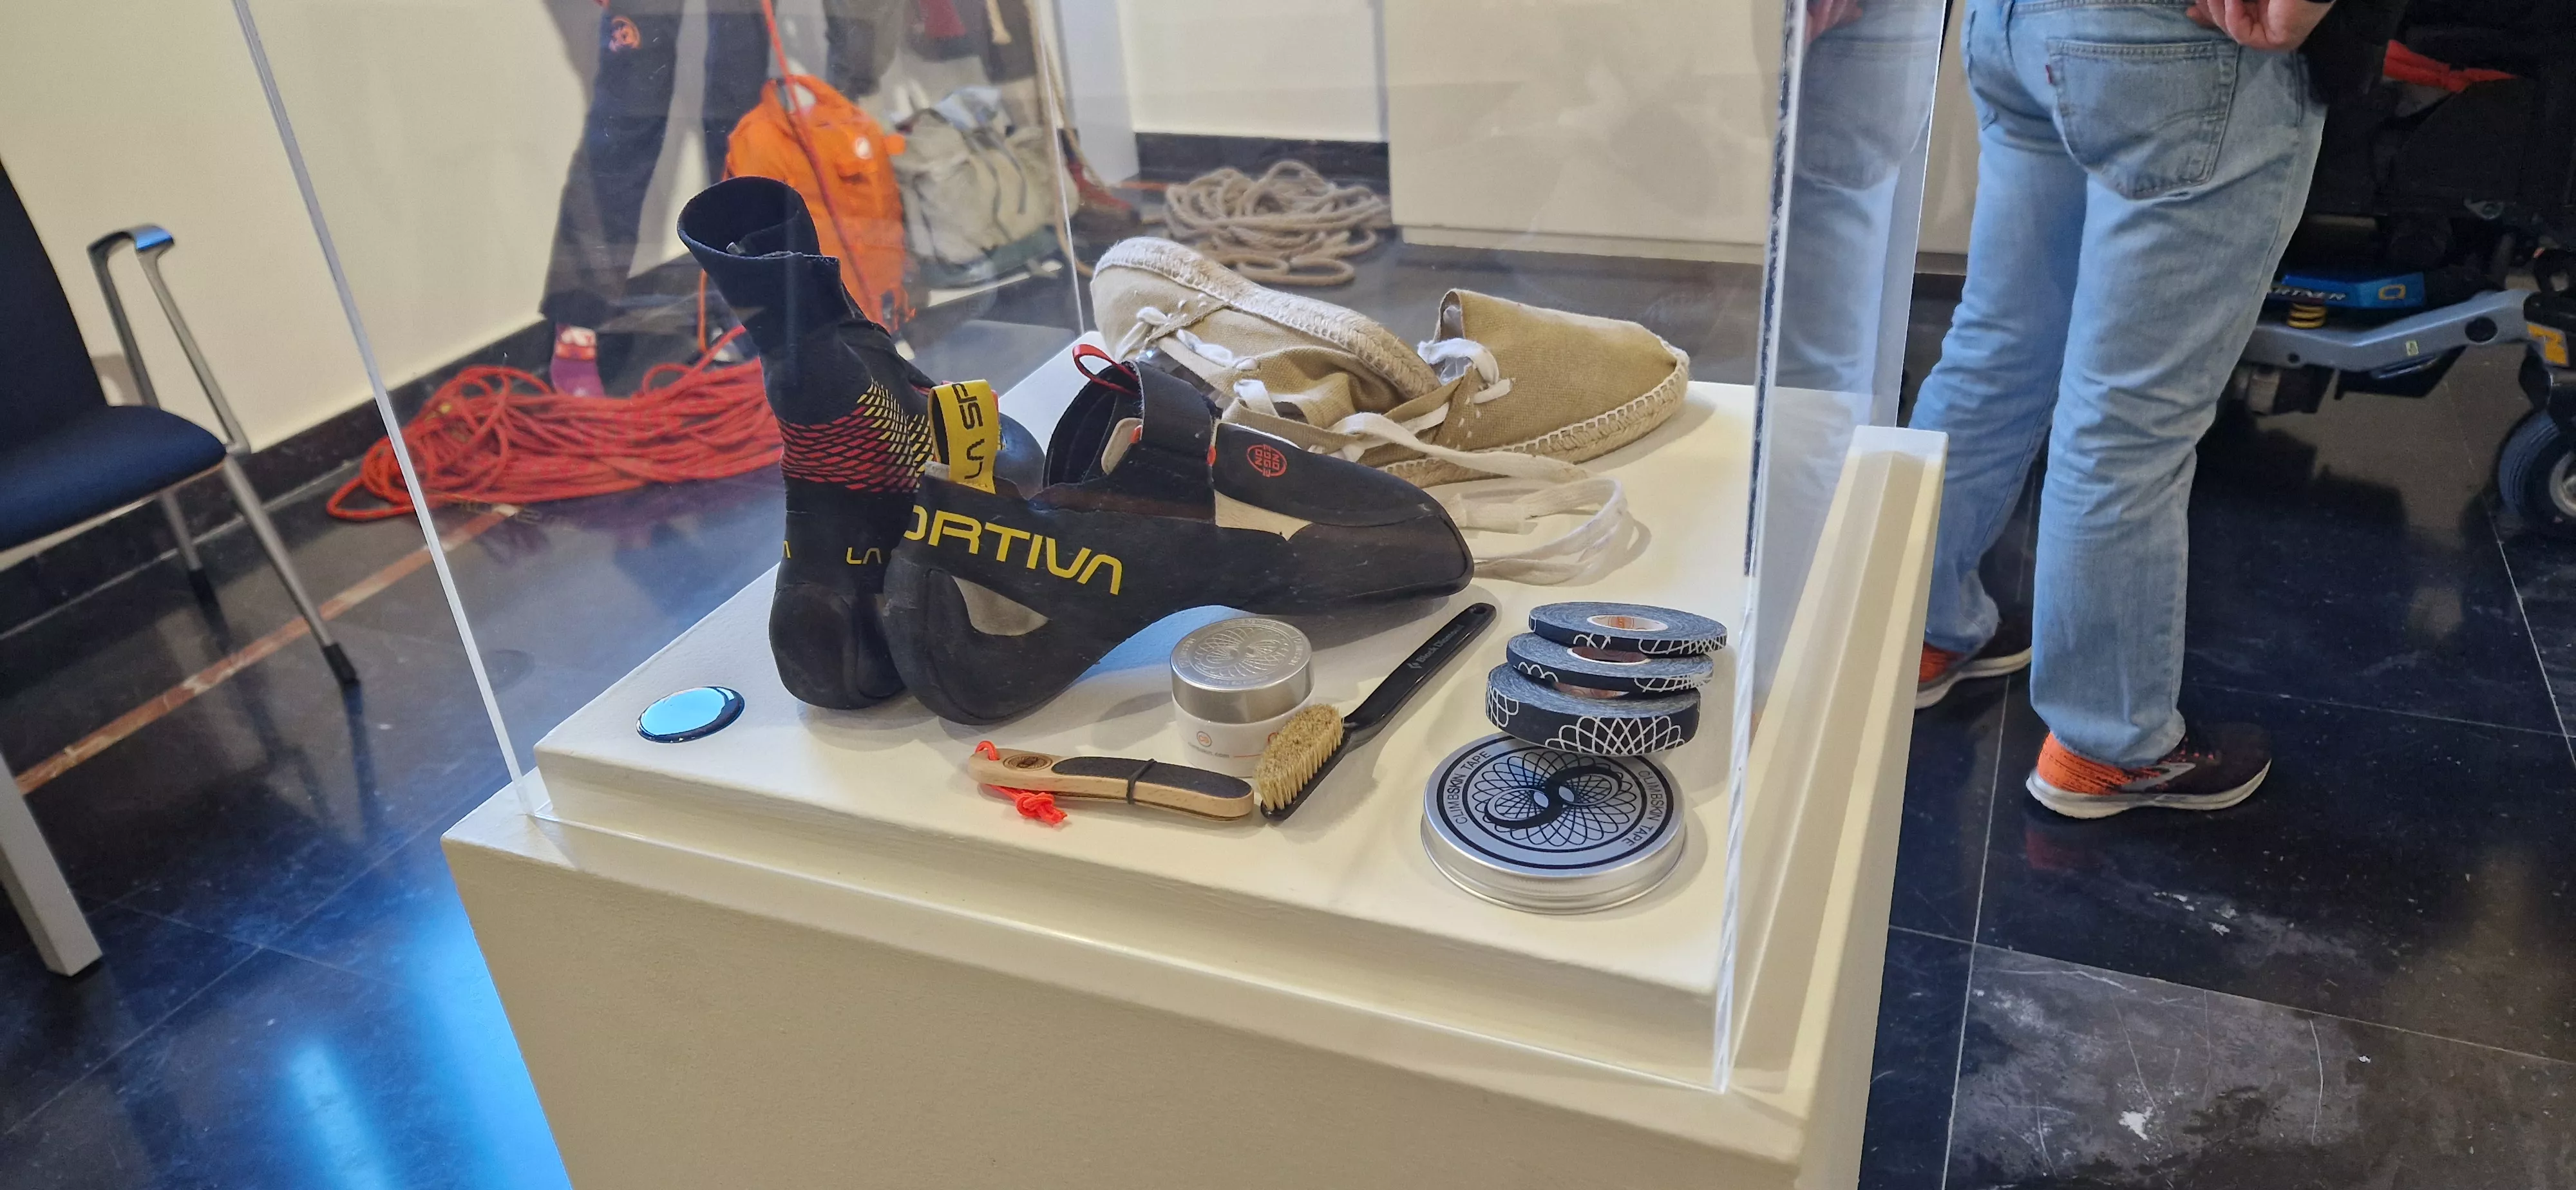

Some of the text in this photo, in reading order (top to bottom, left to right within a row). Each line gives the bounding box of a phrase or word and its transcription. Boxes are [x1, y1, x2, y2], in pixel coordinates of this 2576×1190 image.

[846, 547, 882, 564] LA
[1415, 647, 1440, 663] Black
[1446, 750, 1492, 824] CLIMBSKIN TAPE
[1621, 770, 1665, 847] CLIMBSKIN TAPE
